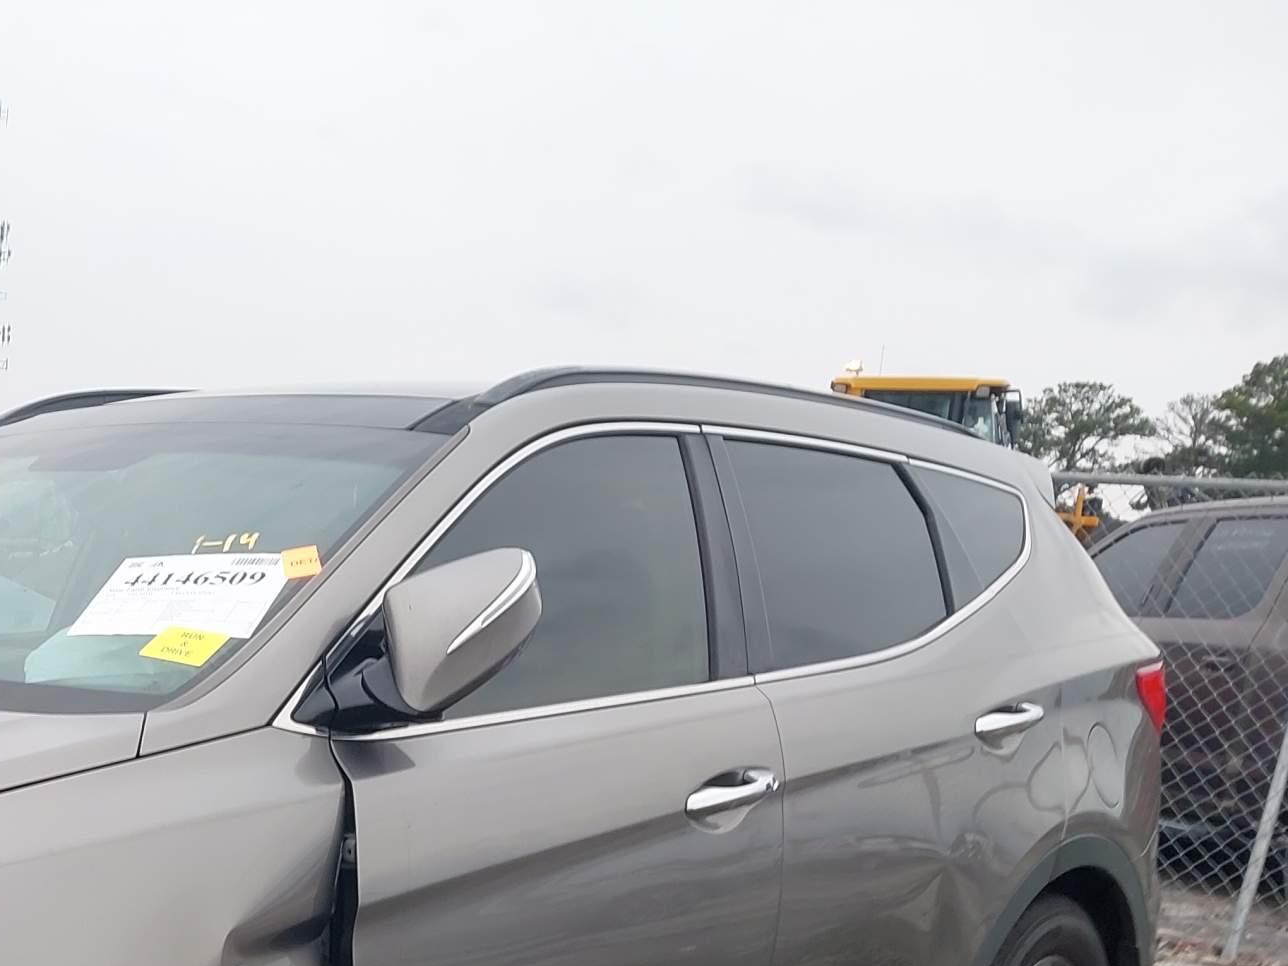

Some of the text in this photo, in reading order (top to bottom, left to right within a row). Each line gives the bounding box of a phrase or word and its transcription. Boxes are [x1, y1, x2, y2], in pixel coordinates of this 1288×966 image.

[124, 570, 266, 587] 44146509
[180, 631, 205, 641] RUN
[160, 646, 193, 658] DRIVE
